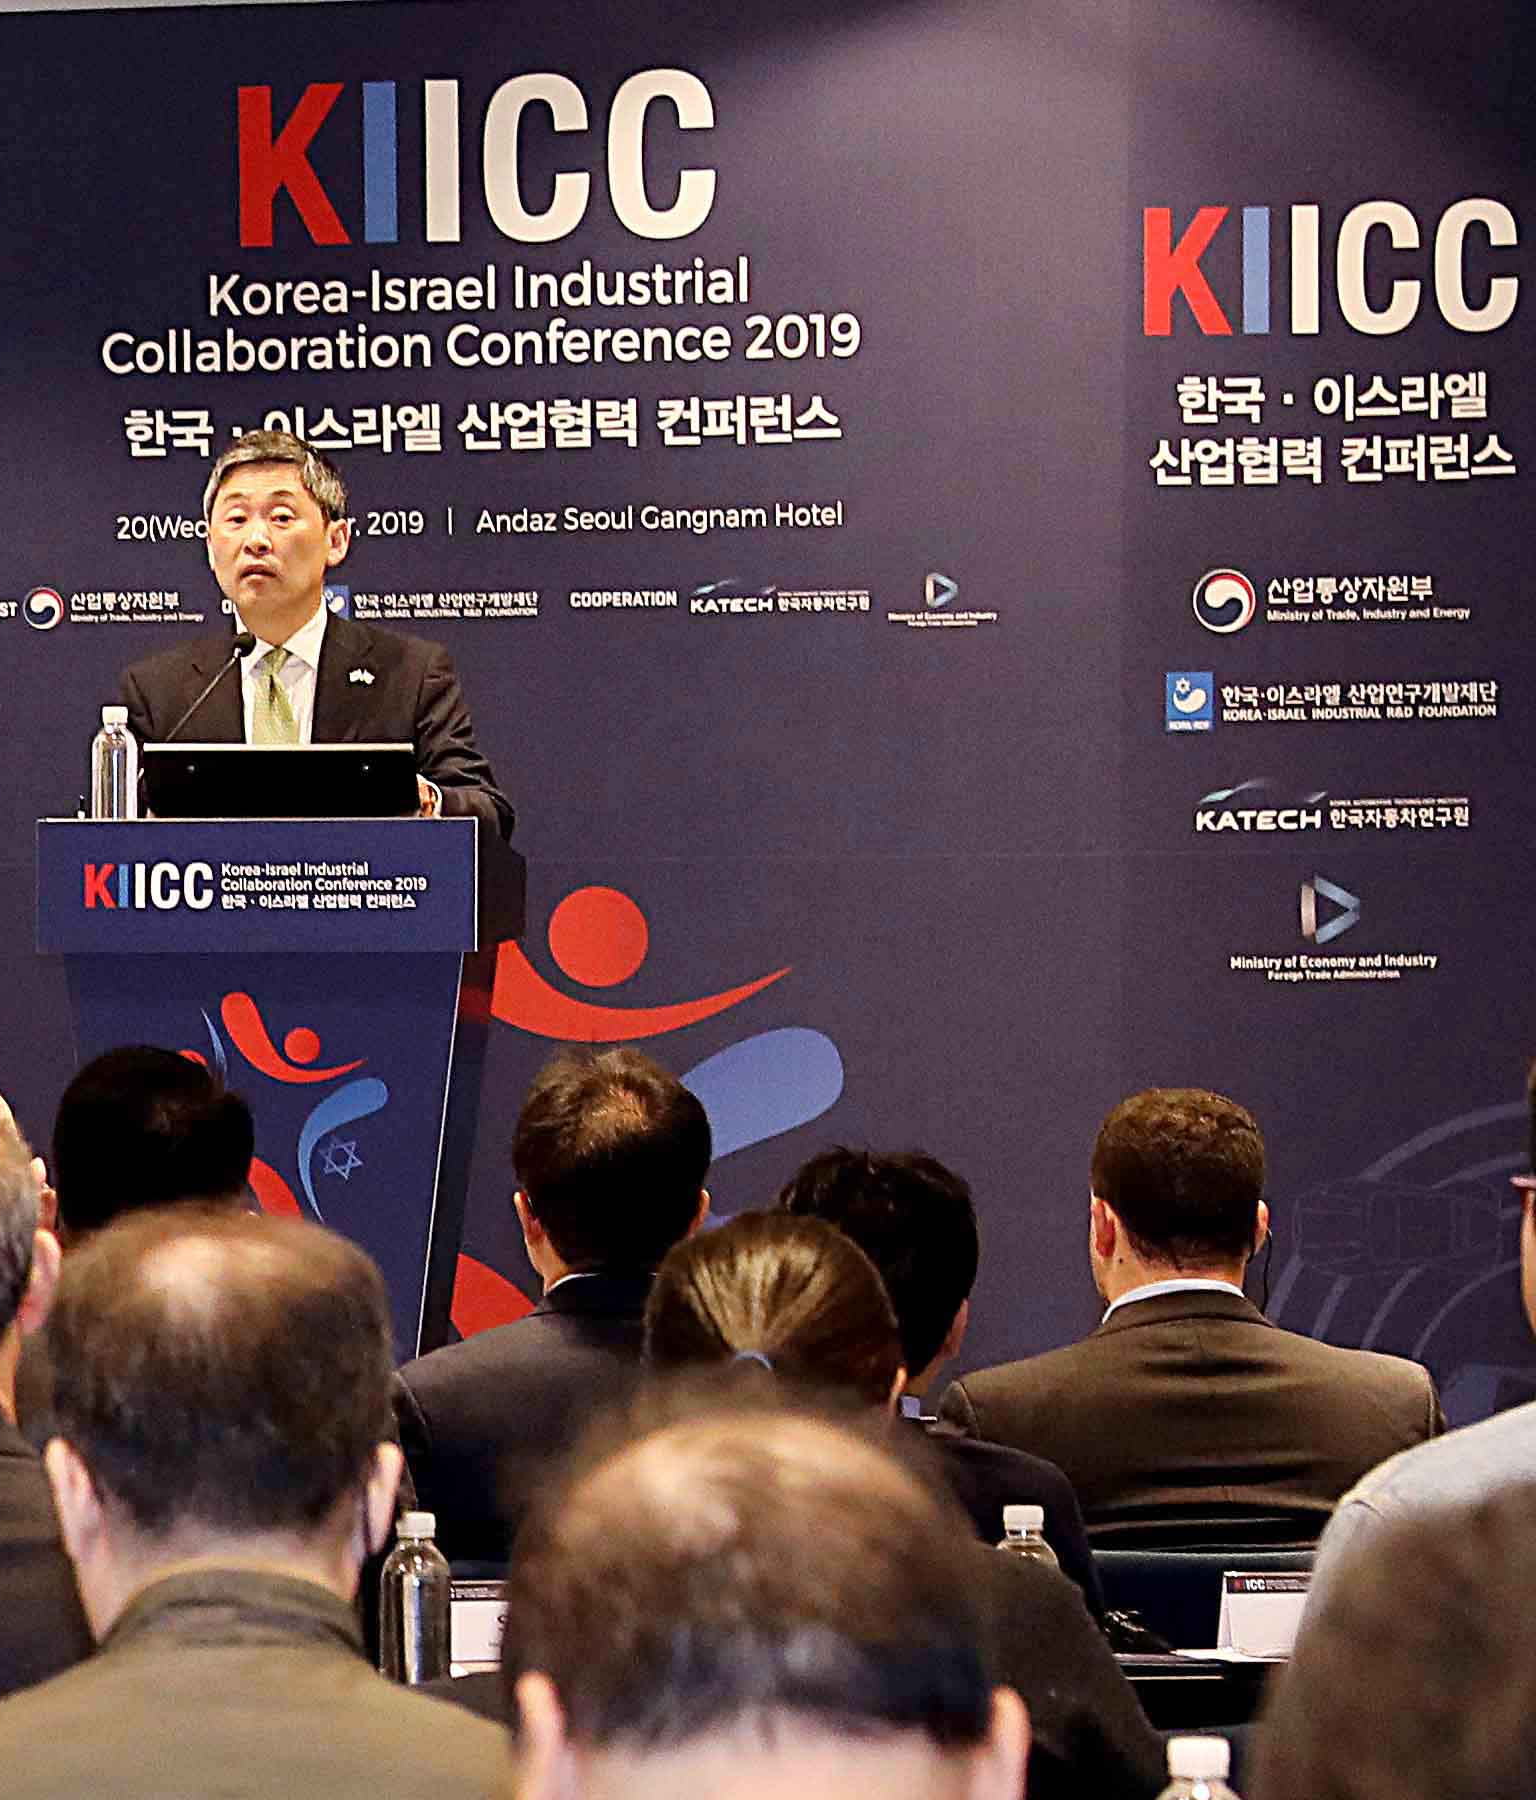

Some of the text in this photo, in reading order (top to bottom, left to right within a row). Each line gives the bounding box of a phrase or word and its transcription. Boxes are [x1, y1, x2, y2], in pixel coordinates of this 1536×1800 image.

[238, 68, 715, 248] KIICC
[1143, 198, 1518, 335] KIICC
[210, 256, 749, 317] Korea-Israel Industrial
[102, 315, 861, 374] Collaboration Conference 2019
[1177, 371, 1487, 423] 한국 이스라엘
[124, 412, 214, 458] 한국
[458, 400, 638, 449] 산업협력
[657, 398, 841, 446] 컨퍼런스
[1149, 434, 1517, 485] 산업협력 컨퍼런스
[367, 512, 424, 534] 2019
[477, 510, 557, 533] Andaz
[564, 507, 633, 530] Seoul
[641, 504, 767, 535] Gangnam
[775, 503, 843, 527] Hotel
[71, 592, 179, 610] 산업통상자원부
[570, 592, 677, 608] COOPERATION
[1267, 576, 1433, 604] 산업통상자원부
[690, 598, 773, 613] KATECH
[1266, 609, 1309, 622] Ministry
[1312, 609, 1323, 621] of
[1363, 608, 1407, 620] Industry
[1409, 608, 1430, 618] and
[1433, 607, 1470, 619] Energy
[1222, 681, 1498, 707] 한국·이스라엘 산업연구개발재단
[1312, 707, 1381, 720] INDUSTRIAL
[1387, 707, 1413, 718] R&D
[1419, 705, 1497, 717] FOUNDATION
[1196, 810, 1321, 831] KATECH
[305, 862, 369, 876] Industrial
[84, 862, 214, 909] KIICC
[221, 877, 427, 891] Collaboration Conference 2019
[1230, 954, 1437, 970] Ministry of Economy and Industry
